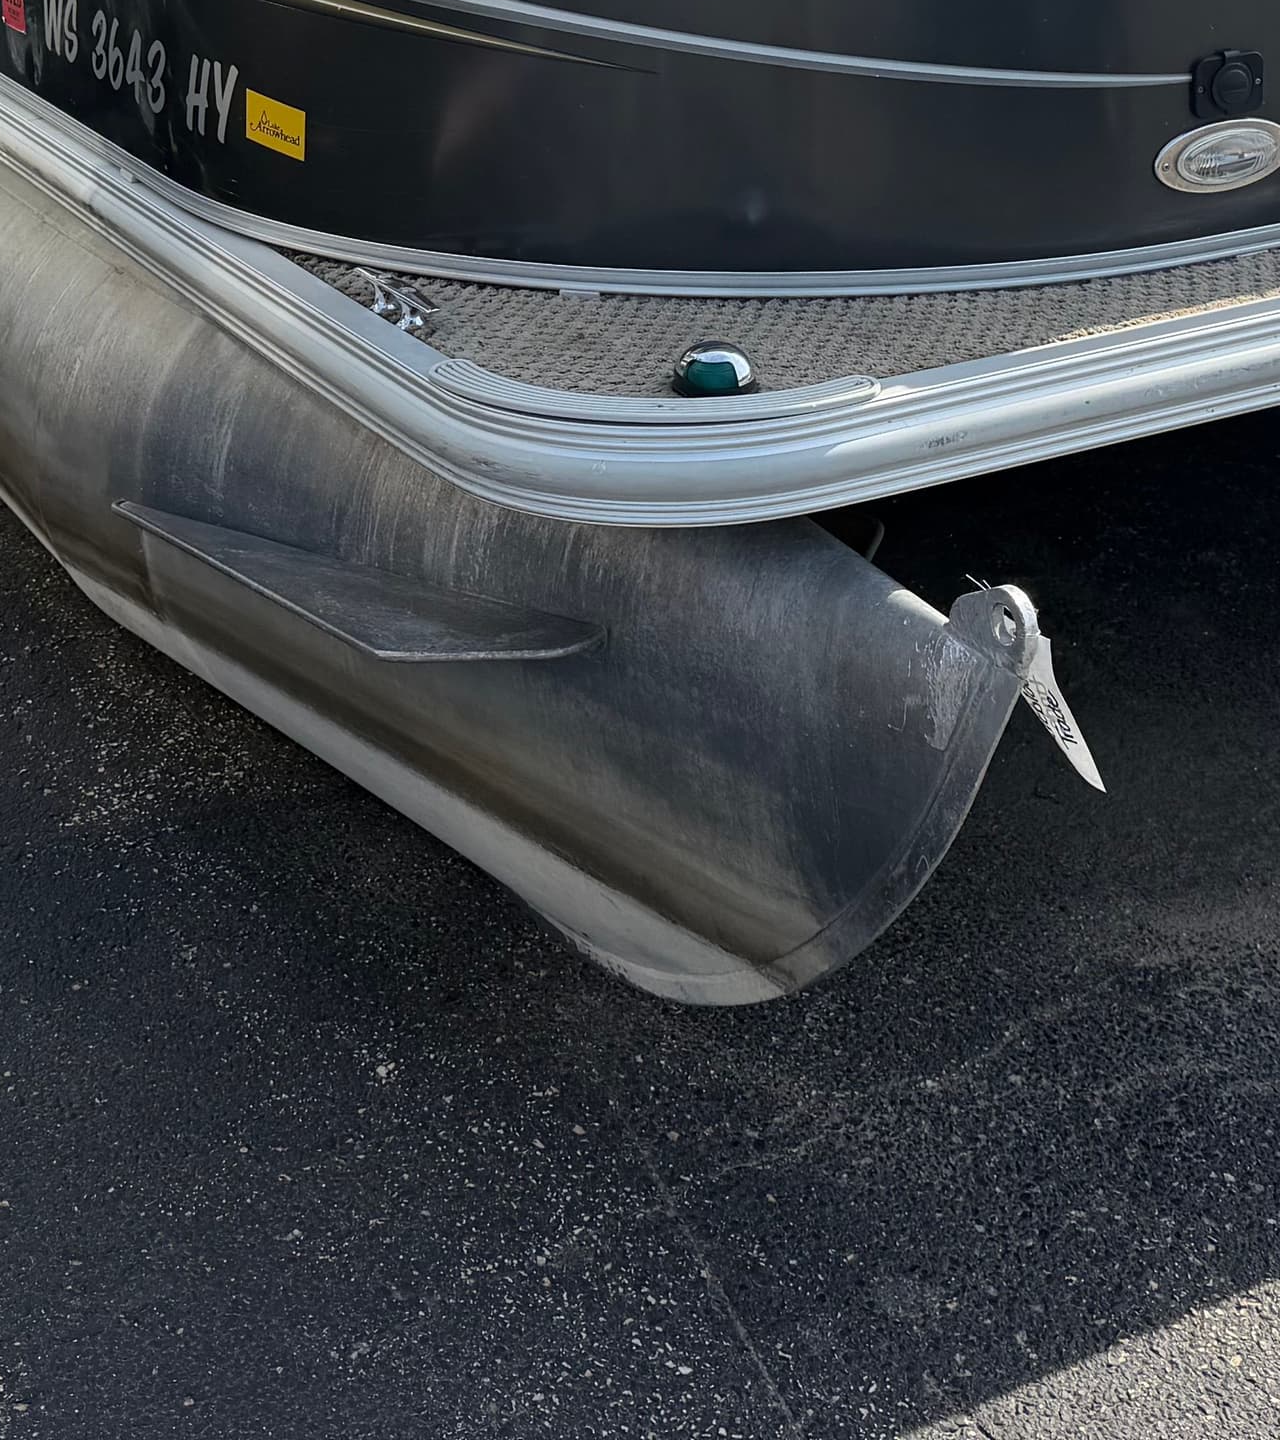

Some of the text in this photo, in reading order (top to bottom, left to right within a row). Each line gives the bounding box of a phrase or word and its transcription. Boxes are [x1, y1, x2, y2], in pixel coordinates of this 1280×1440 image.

[91, 10, 166, 114] 3643
[185, 53, 239, 144] HY
[250, 120, 300, 147] Arrowhead
